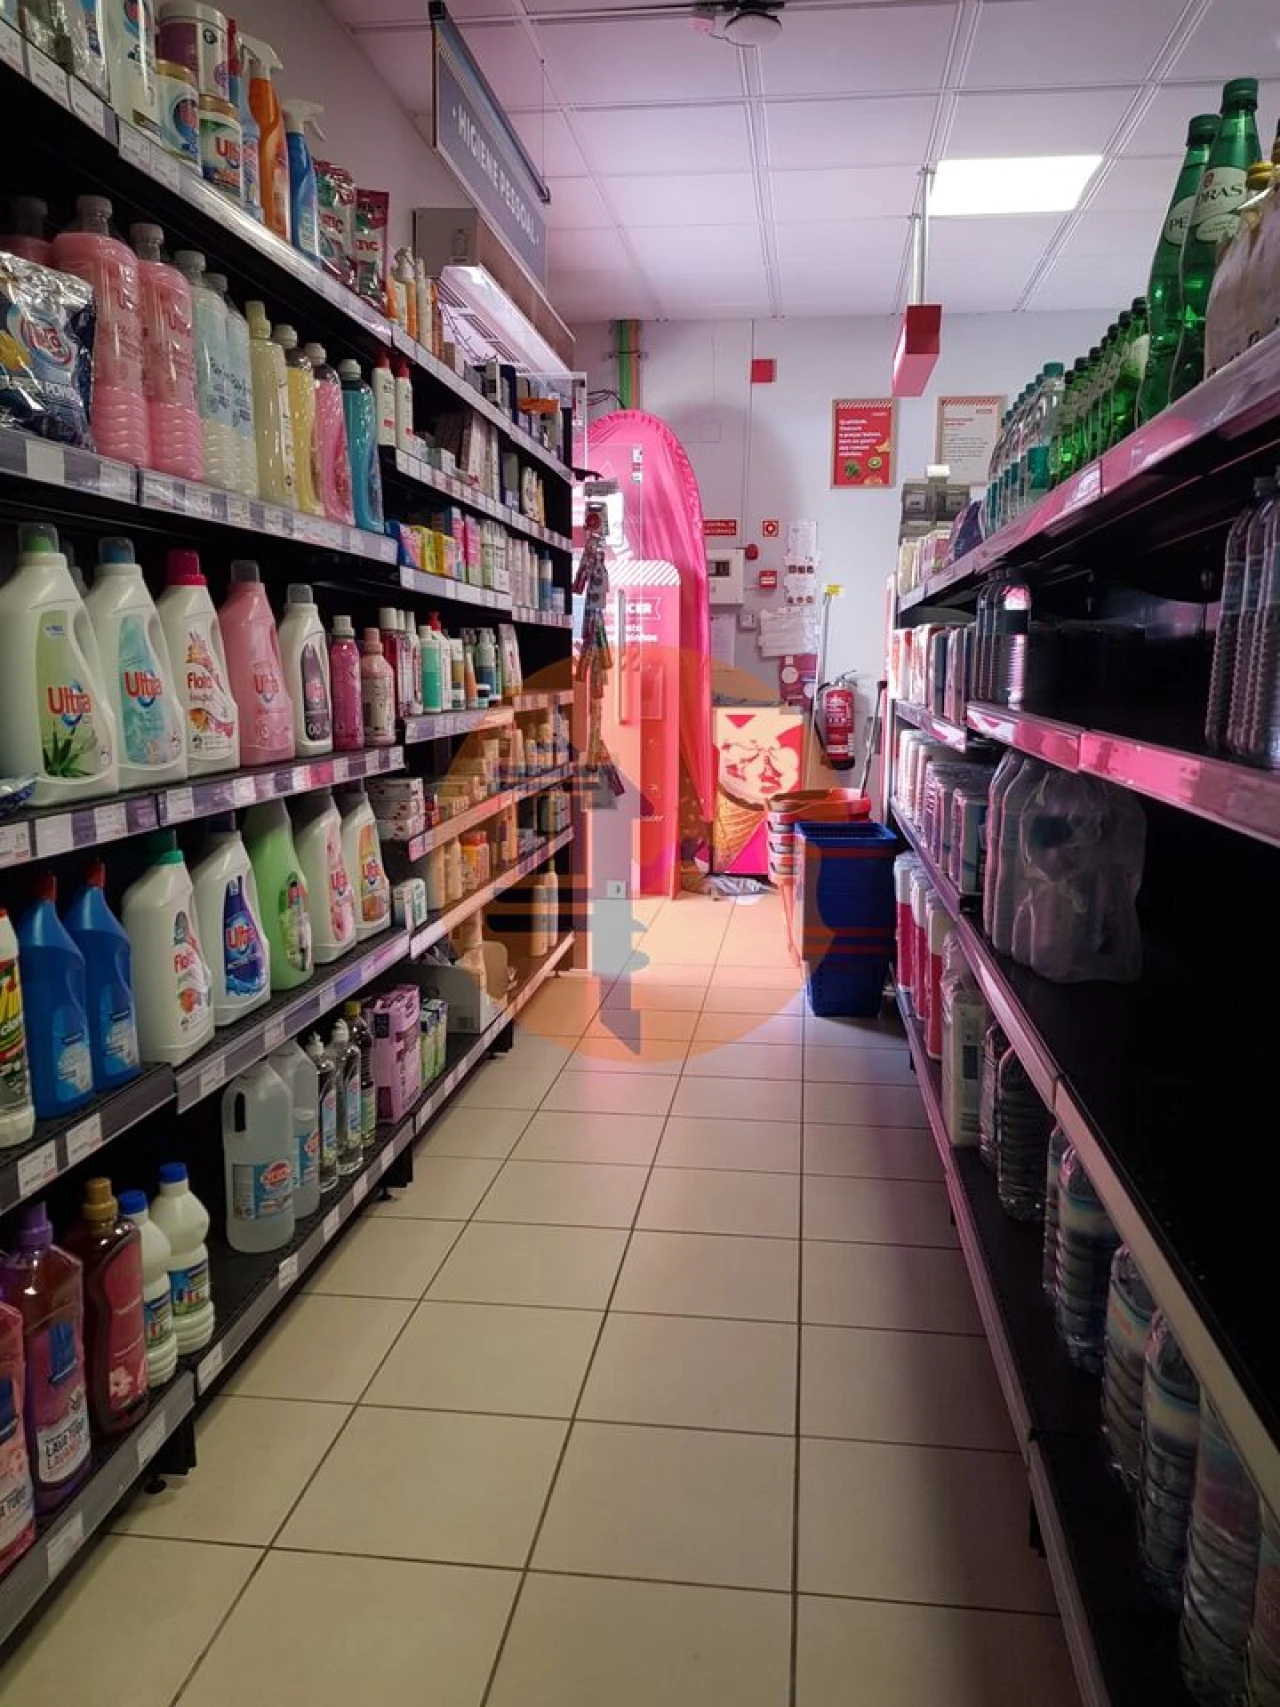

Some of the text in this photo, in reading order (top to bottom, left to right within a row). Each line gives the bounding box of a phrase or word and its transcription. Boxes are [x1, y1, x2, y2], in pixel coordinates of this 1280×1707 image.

[457, 104, 537, 245] HIGIENE PESSOAL
[47, 683, 92, 714] Ultra
[123, 670, 164, 699] Ultra
